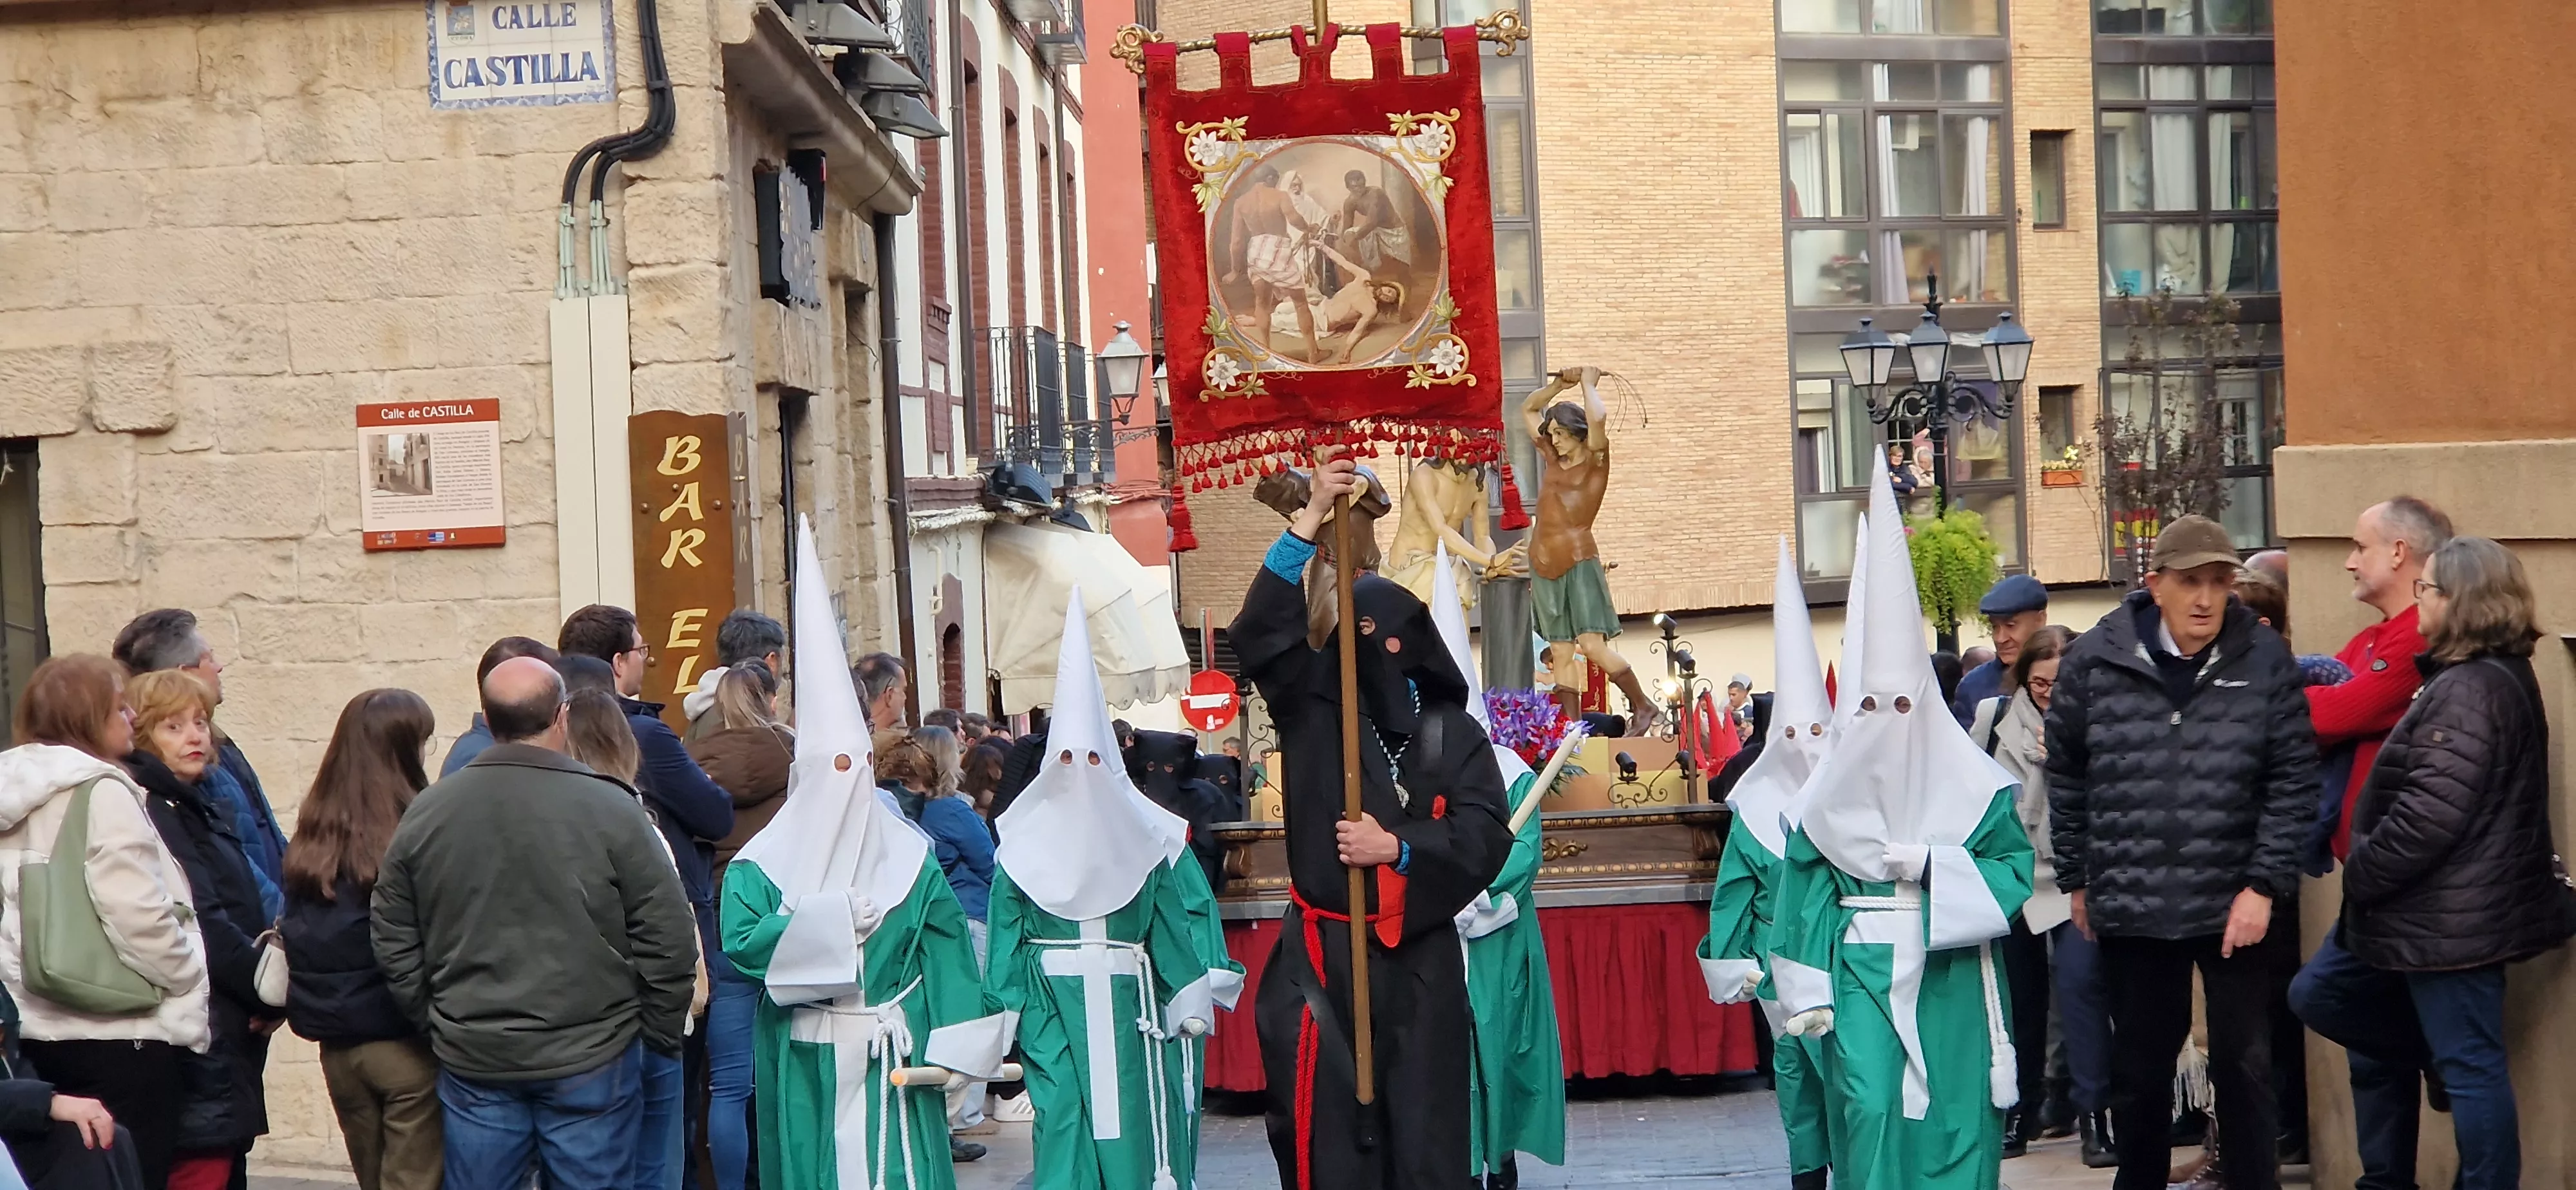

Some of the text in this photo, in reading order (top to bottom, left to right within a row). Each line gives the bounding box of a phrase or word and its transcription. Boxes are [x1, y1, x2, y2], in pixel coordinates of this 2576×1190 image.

[492, 2, 576, 30] CALLE
[443, 51, 600, 89] CASTILLA
[381, 404, 474, 419] Calle de CASTILLA
[734, 433, 748, 564] BAR
[657, 435, 709, 695] BAR EL
